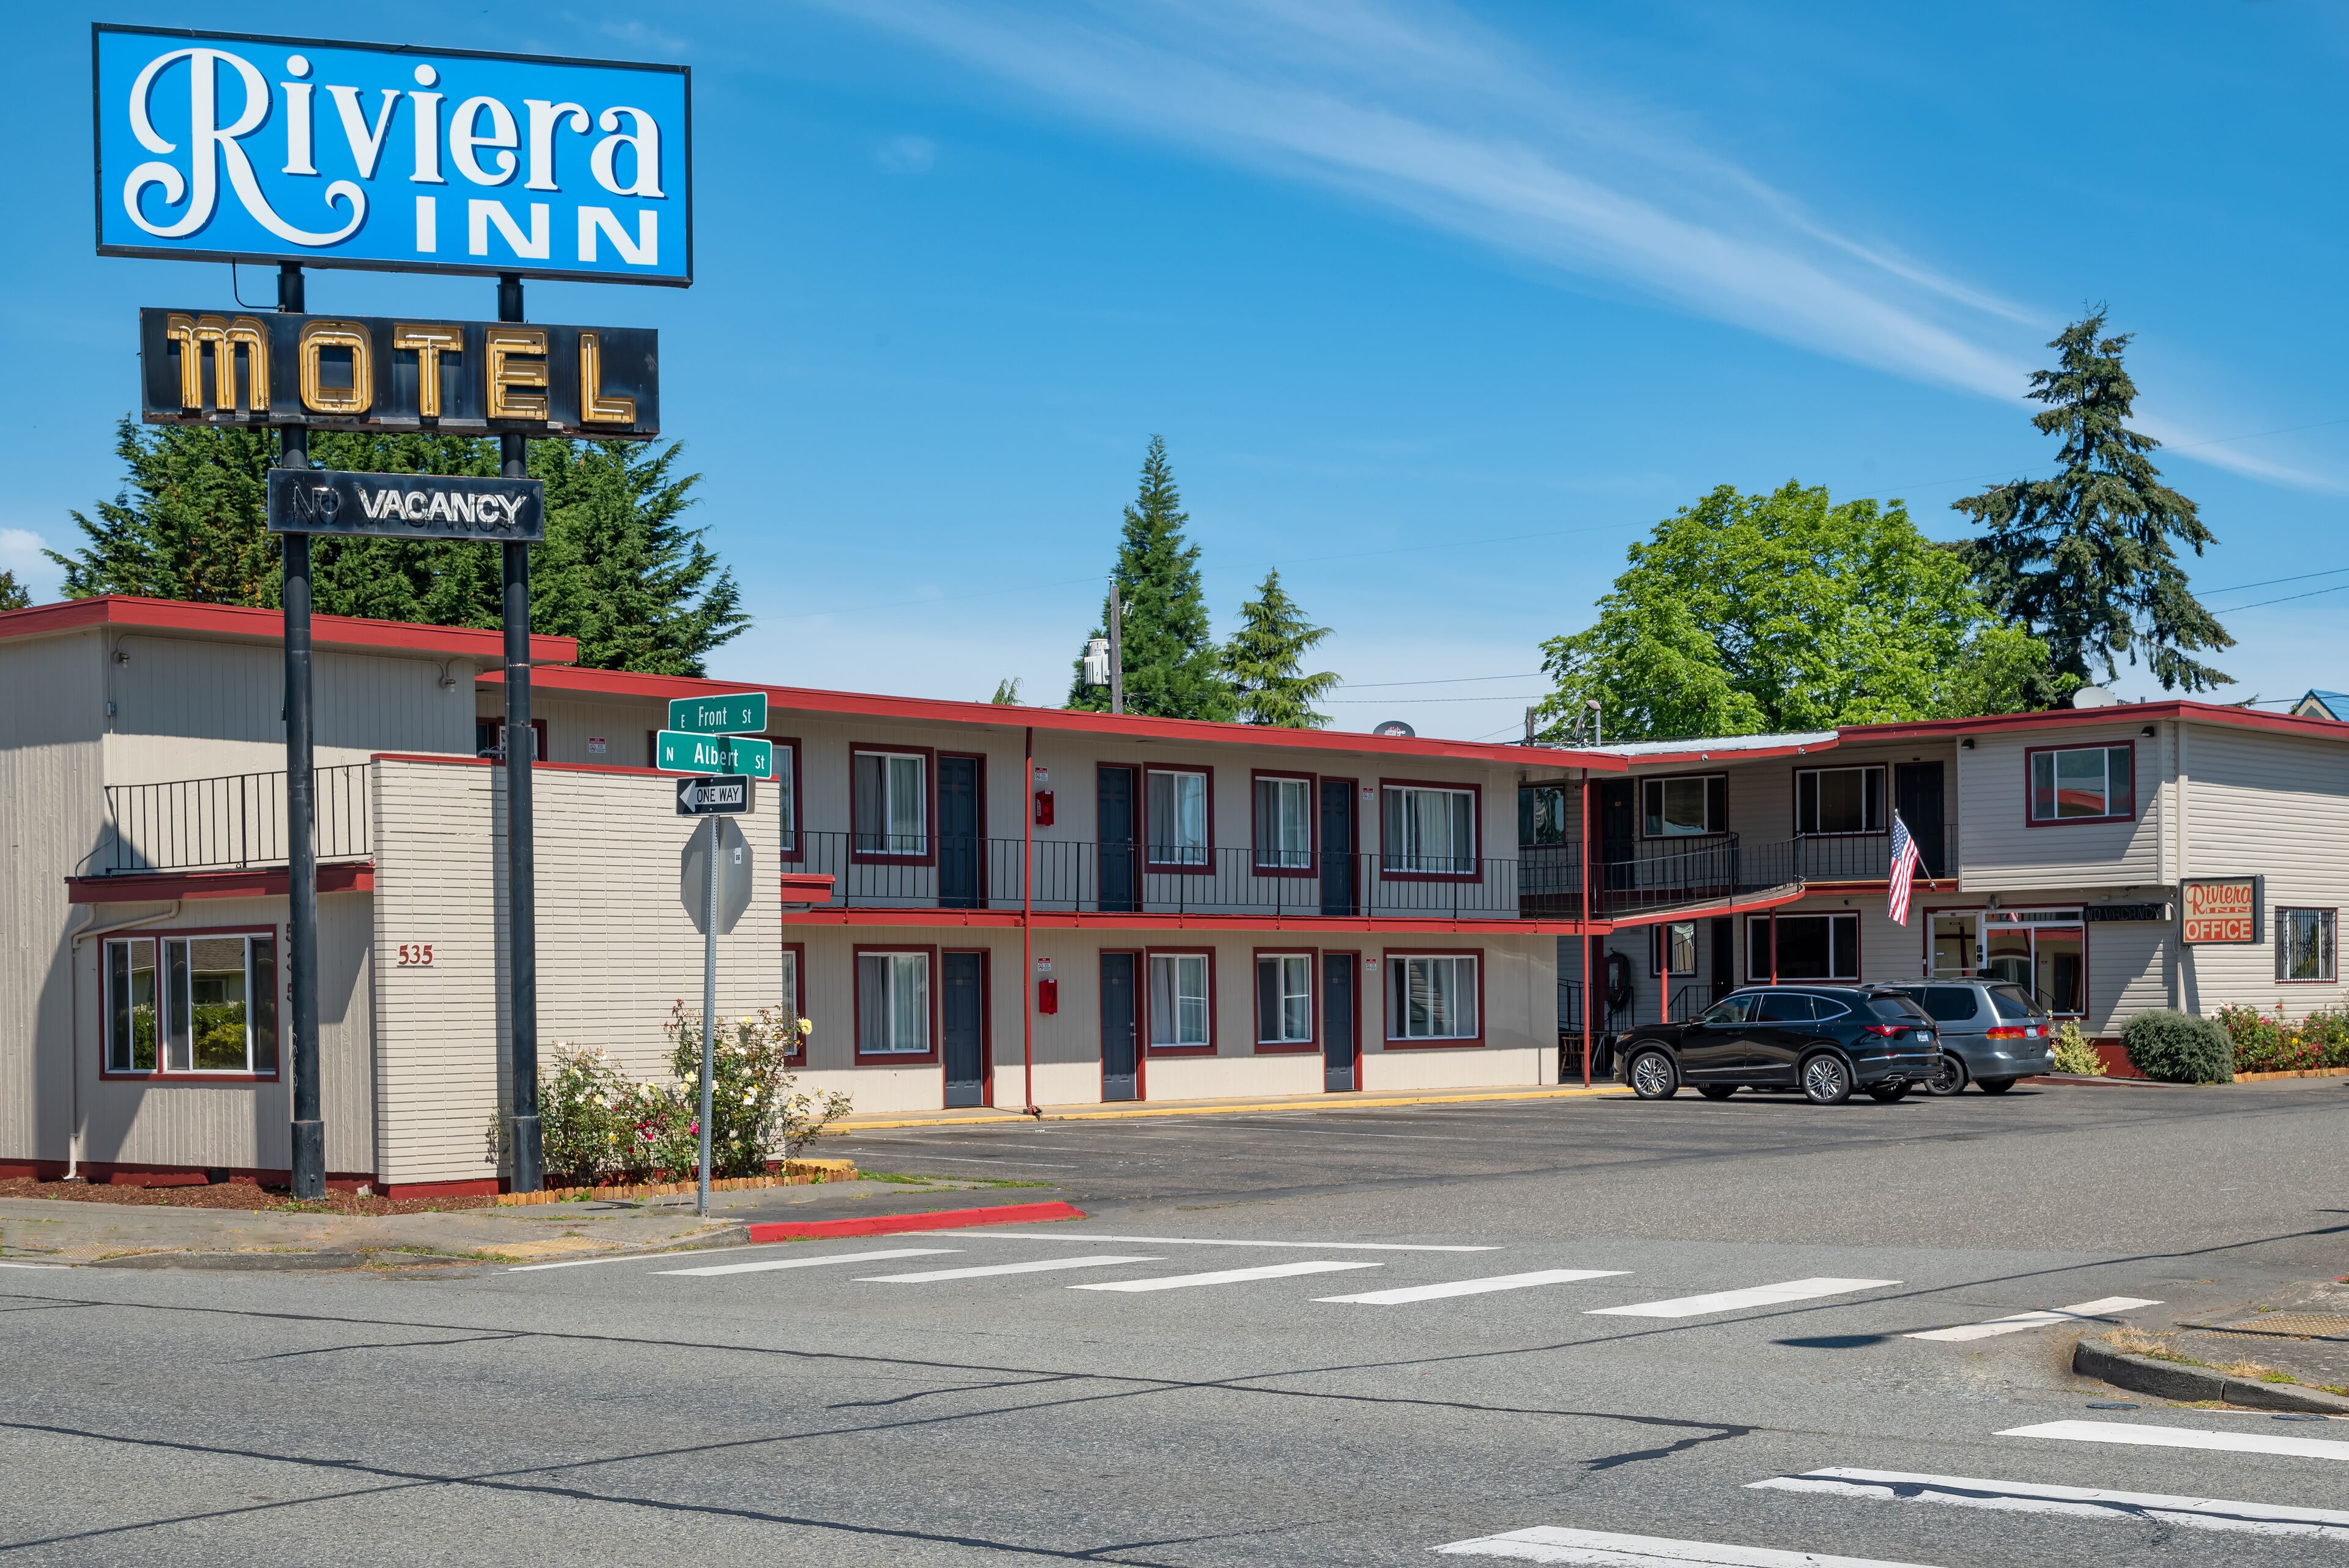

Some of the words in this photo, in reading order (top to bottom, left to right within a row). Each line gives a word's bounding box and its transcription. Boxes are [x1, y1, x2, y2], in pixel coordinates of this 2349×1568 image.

[123, 48, 665, 246] Riviera
[417, 196, 658, 266] INN
[167, 313, 636, 424] MOTEL
[293, 485, 341, 515] NO
[358, 489, 528, 525] VACANCY
[681, 714, 685, 729] E
[698, 706, 727, 727] Front
[742, 708, 751, 724] St
[666, 746, 674, 762] N
[694, 742, 738, 767] Albert
[755, 754, 765, 770] St
[697, 788, 716, 803] ONE
[719, 787, 740, 802] WAY
[2185, 883, 2251, 915] Riviera
[2085, 908, 2101, 921] NO
[2104, 906, 2161, 920] VACANCY
[2186, 920, 2251, 940] OFFICE
[399, 944, 433, 965] 535
